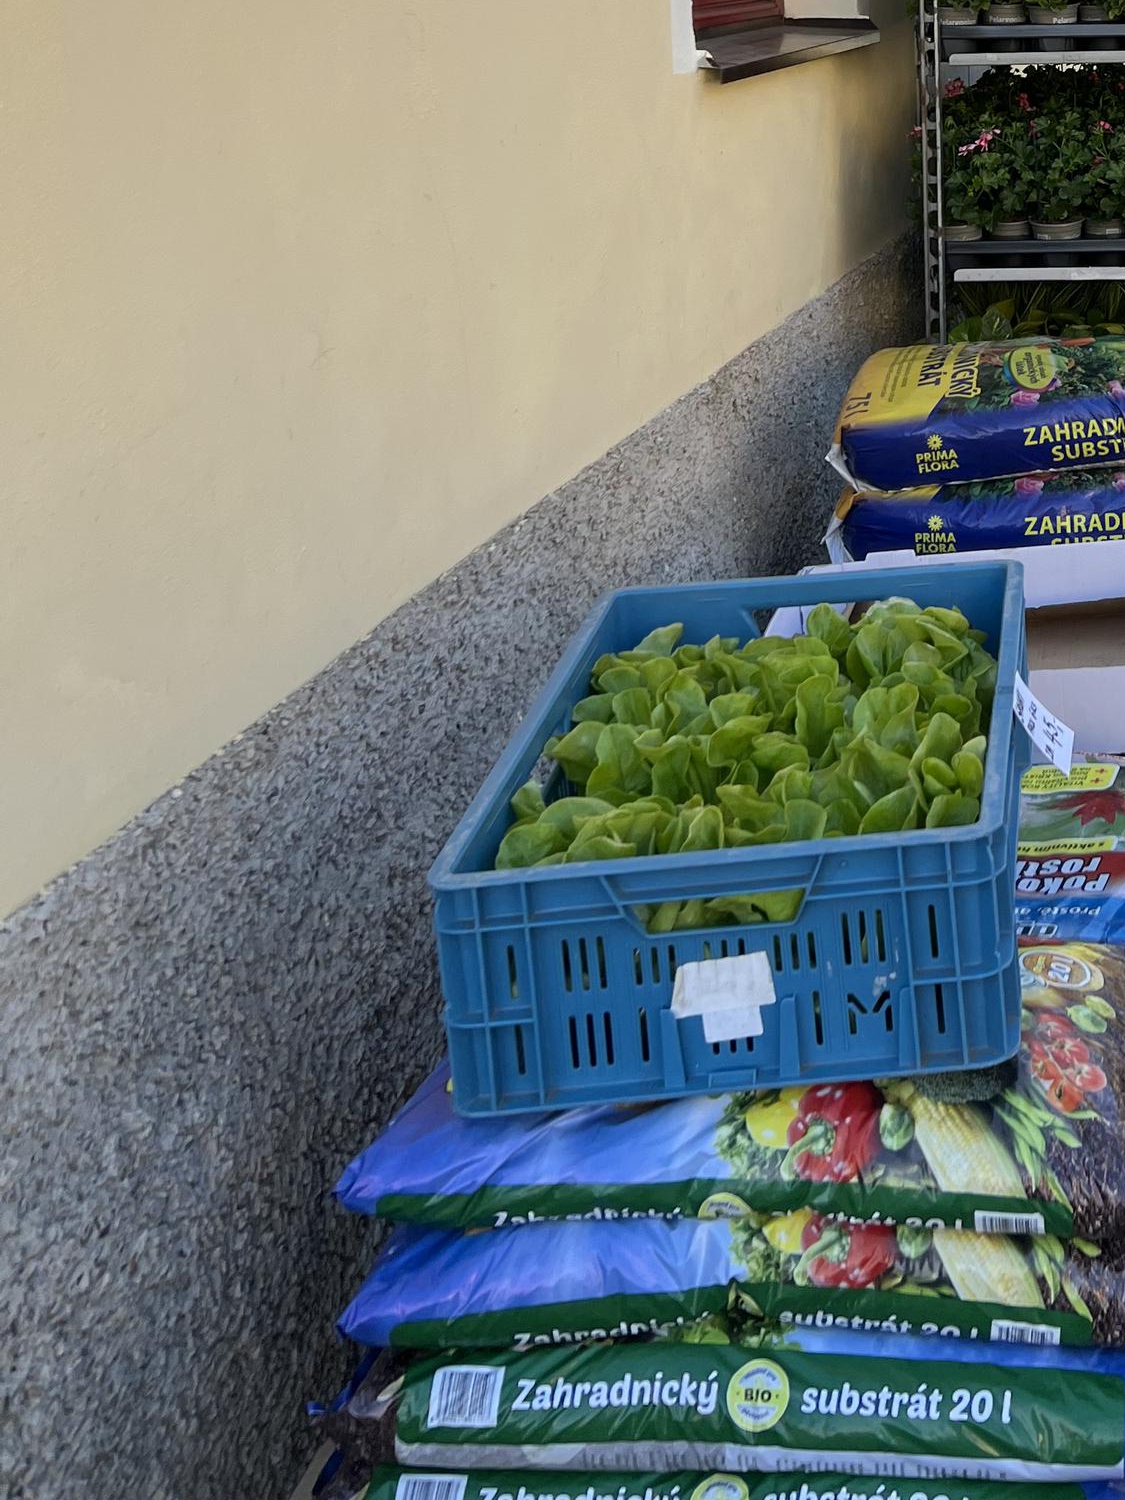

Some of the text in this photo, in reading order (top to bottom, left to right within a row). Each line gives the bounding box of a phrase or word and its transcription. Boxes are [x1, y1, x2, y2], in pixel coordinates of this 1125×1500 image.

[915, 448, 958, 464] PRIMA
[918, 459, 960, 474] FLORA
[914, 531, 957, 544] PRIMA
[914, 542, 957, 554] FLORA
[1017, 873, 1111, 896] Poko
[513, 1311, 710, 1351] Zahradni
[511, 1370, 720, 1416] Zahradnický
[743, 1388, 772, 1403] BIO
[800, 1382, 1013, 1425] substrát 20 l
